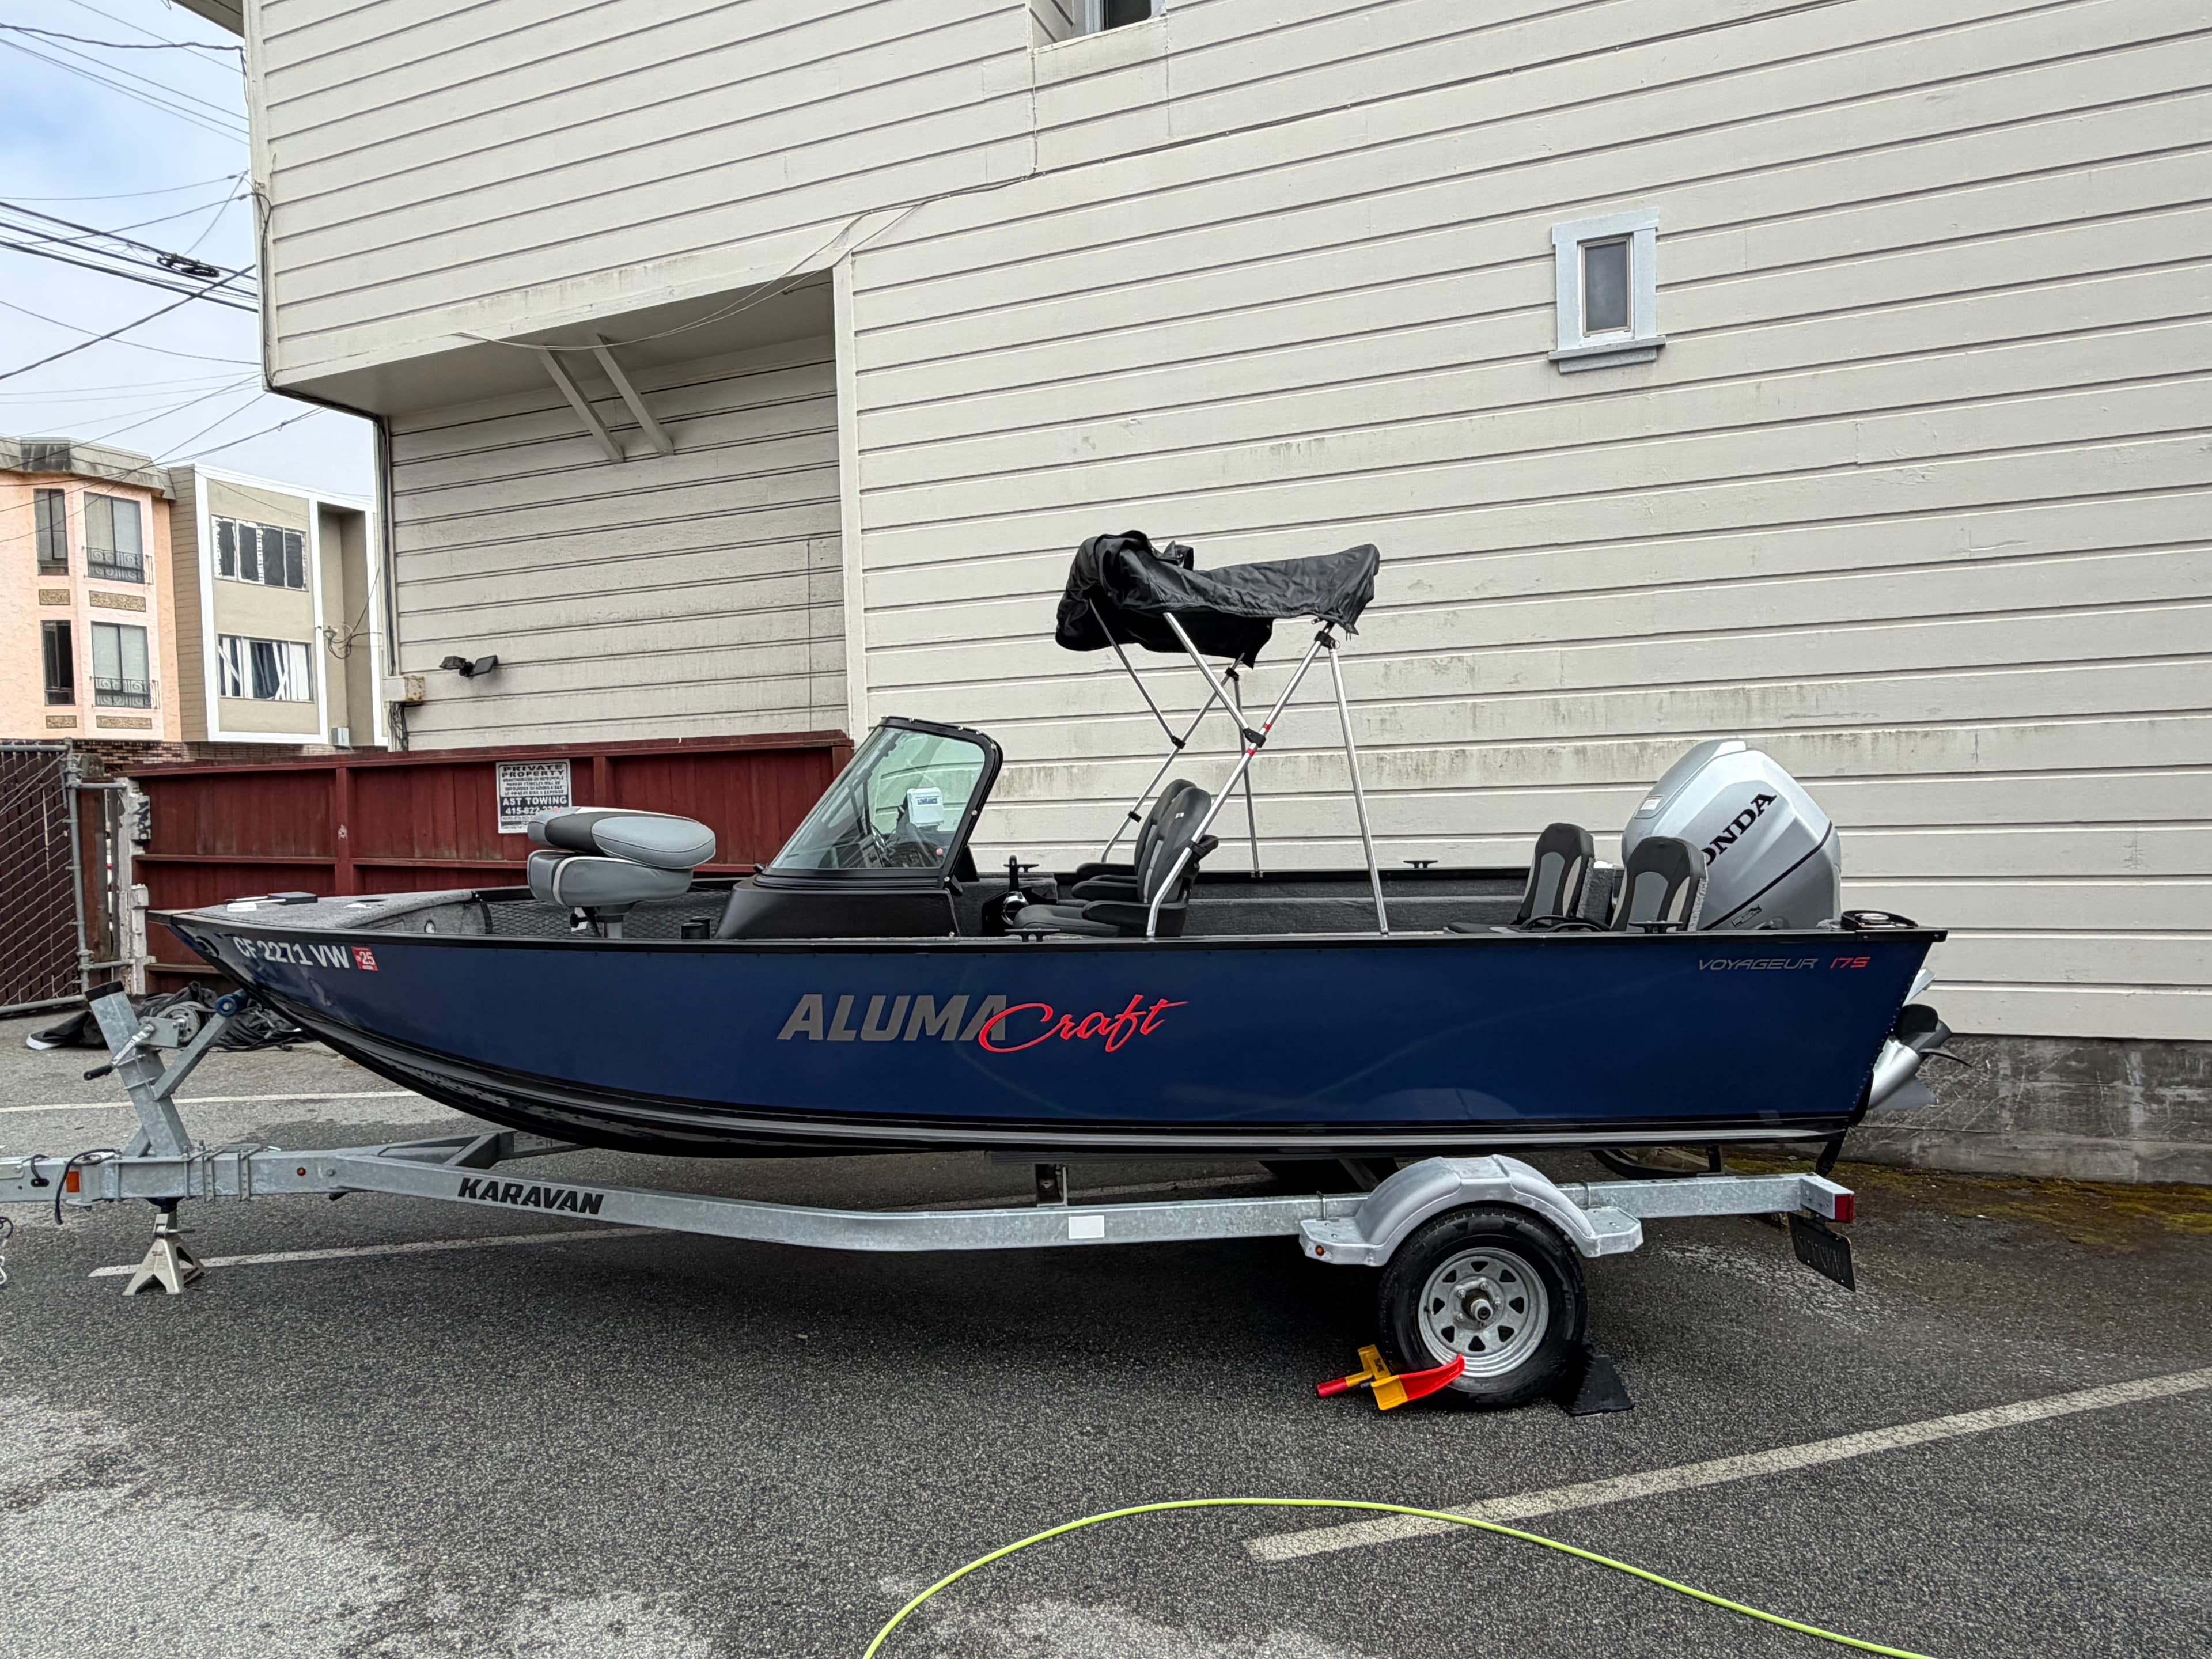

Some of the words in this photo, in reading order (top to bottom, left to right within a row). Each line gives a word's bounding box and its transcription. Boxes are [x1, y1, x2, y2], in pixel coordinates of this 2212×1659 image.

[502, 797, 522, 806] AST
[525, 796, 567, 805] TOWING
[1701, 793, 1777, 866] ONDA
[233, 937, 257, 959] CF
[257, 940, 313, 965] 2271
[308, 944, 350, 968] VW
[359, 951, 376, 965] 25
[1699, 958, 1819, 971] VOYAGEUR
[1830, 956, 1871, 969] 175
[457, 1177, 604, 1215] KARAVAN
